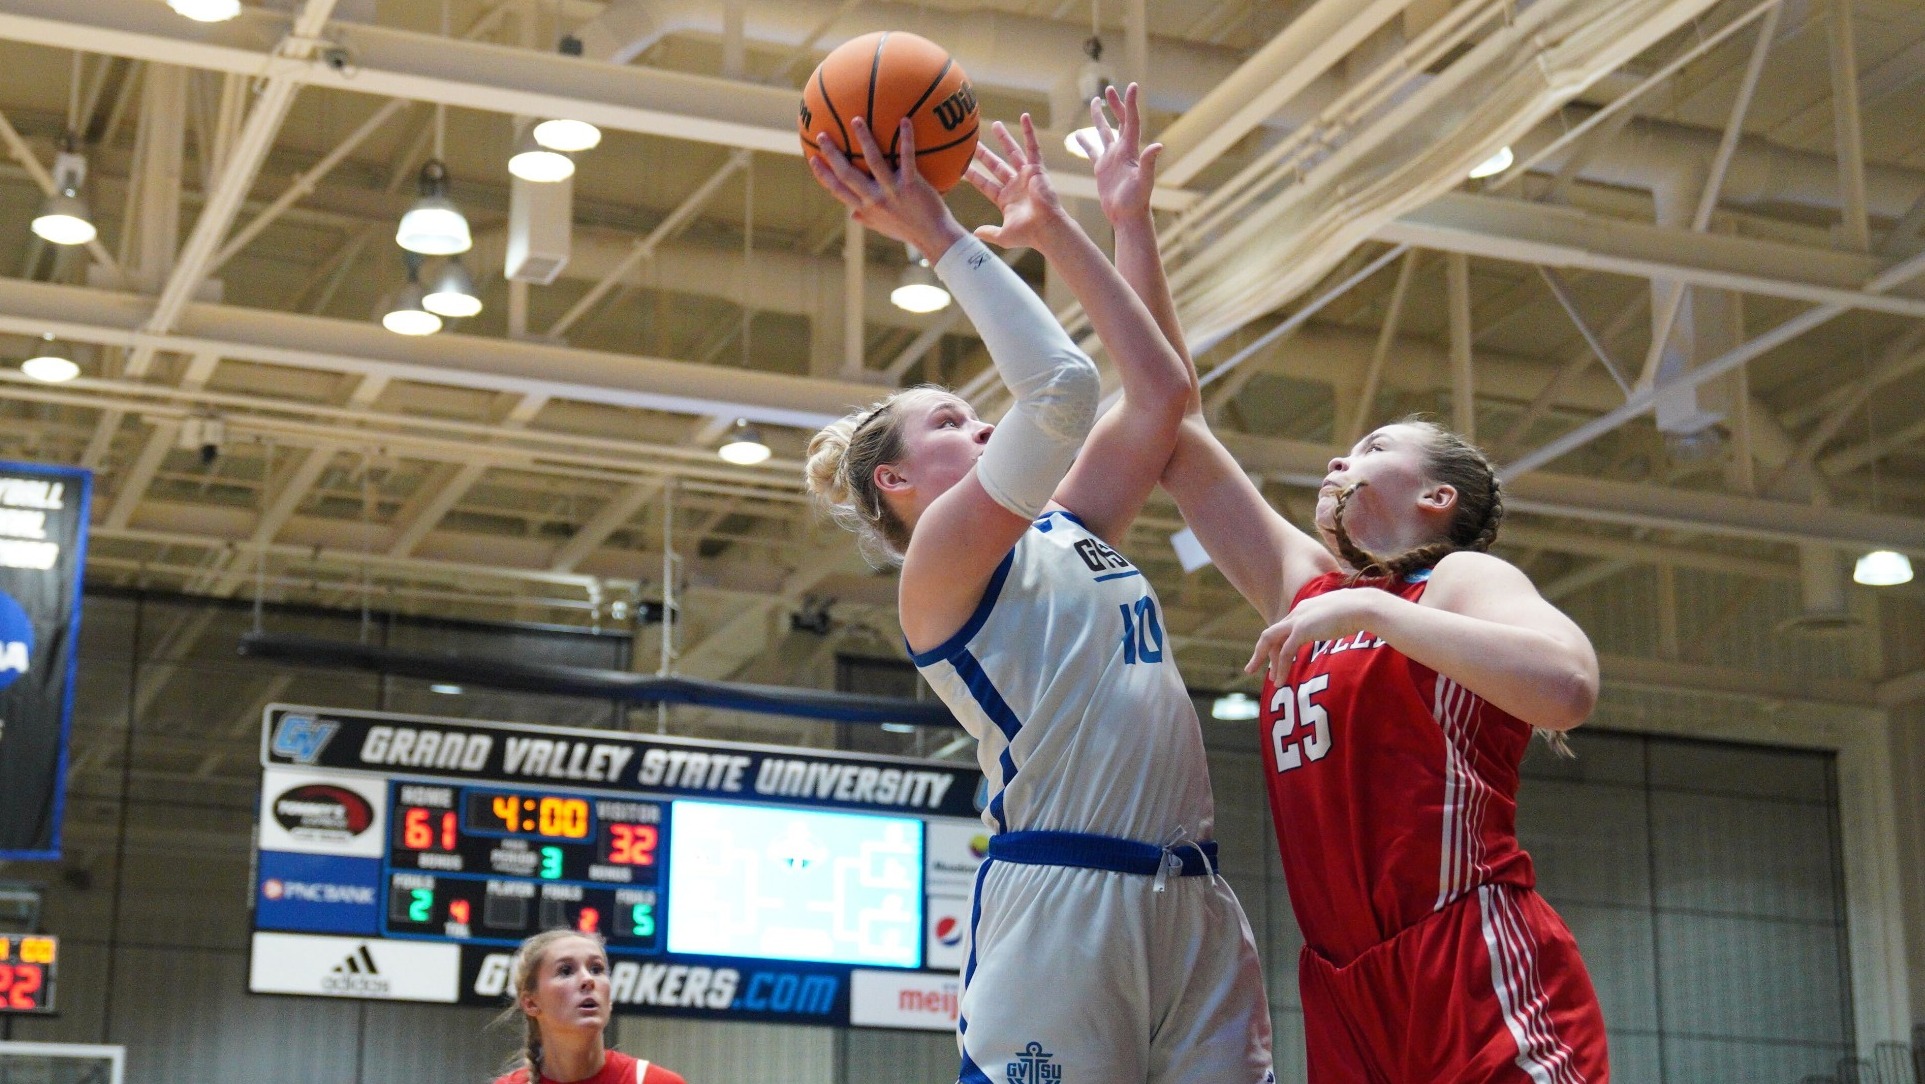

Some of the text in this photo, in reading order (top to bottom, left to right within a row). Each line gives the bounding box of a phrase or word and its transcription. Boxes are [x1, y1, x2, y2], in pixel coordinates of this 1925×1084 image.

[1119, 595, 1163, 665] 10
[272, 711, 341, 763] GV
[1270, 673, 1332, 773] 25
[360, 726, 493, 772] GRAND
[503, 737, 634, 784] VALLEY
[637, 749, 751, 793] STATE
[754, 759, 953, 809] UNIVERSITY
[404, 807, 457, 851] 61
[492, 795, 588, 838] 4:00
[540, 846, 563, 880] 3
[609, 823, 658, 865] 32
[409, 888, 434, 922] 2
[632, 902, 655, 937] 5
[321, 974, 390, 992] adidas
